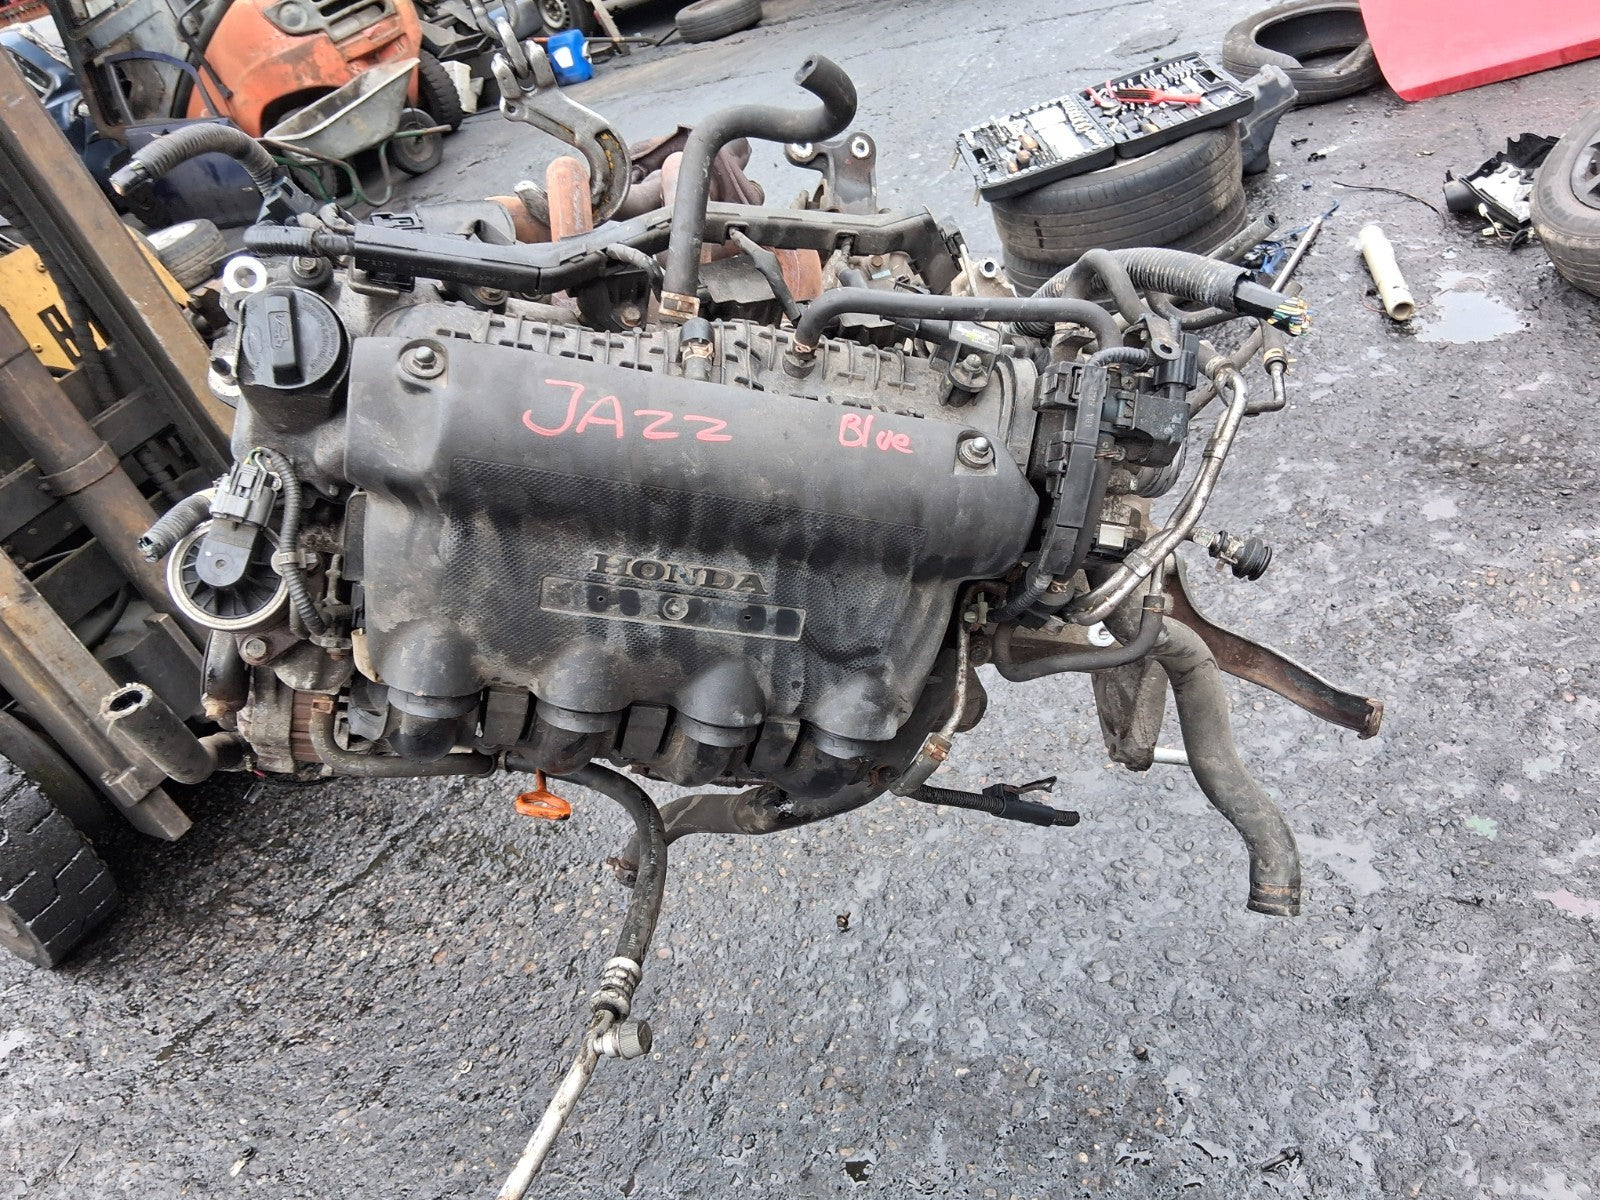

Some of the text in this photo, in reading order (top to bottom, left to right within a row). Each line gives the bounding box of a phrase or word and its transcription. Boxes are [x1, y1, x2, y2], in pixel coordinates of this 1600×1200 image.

[522, 379, 914, 454] JAZZ Blue
[592, 552, 768, 596] HONDA
